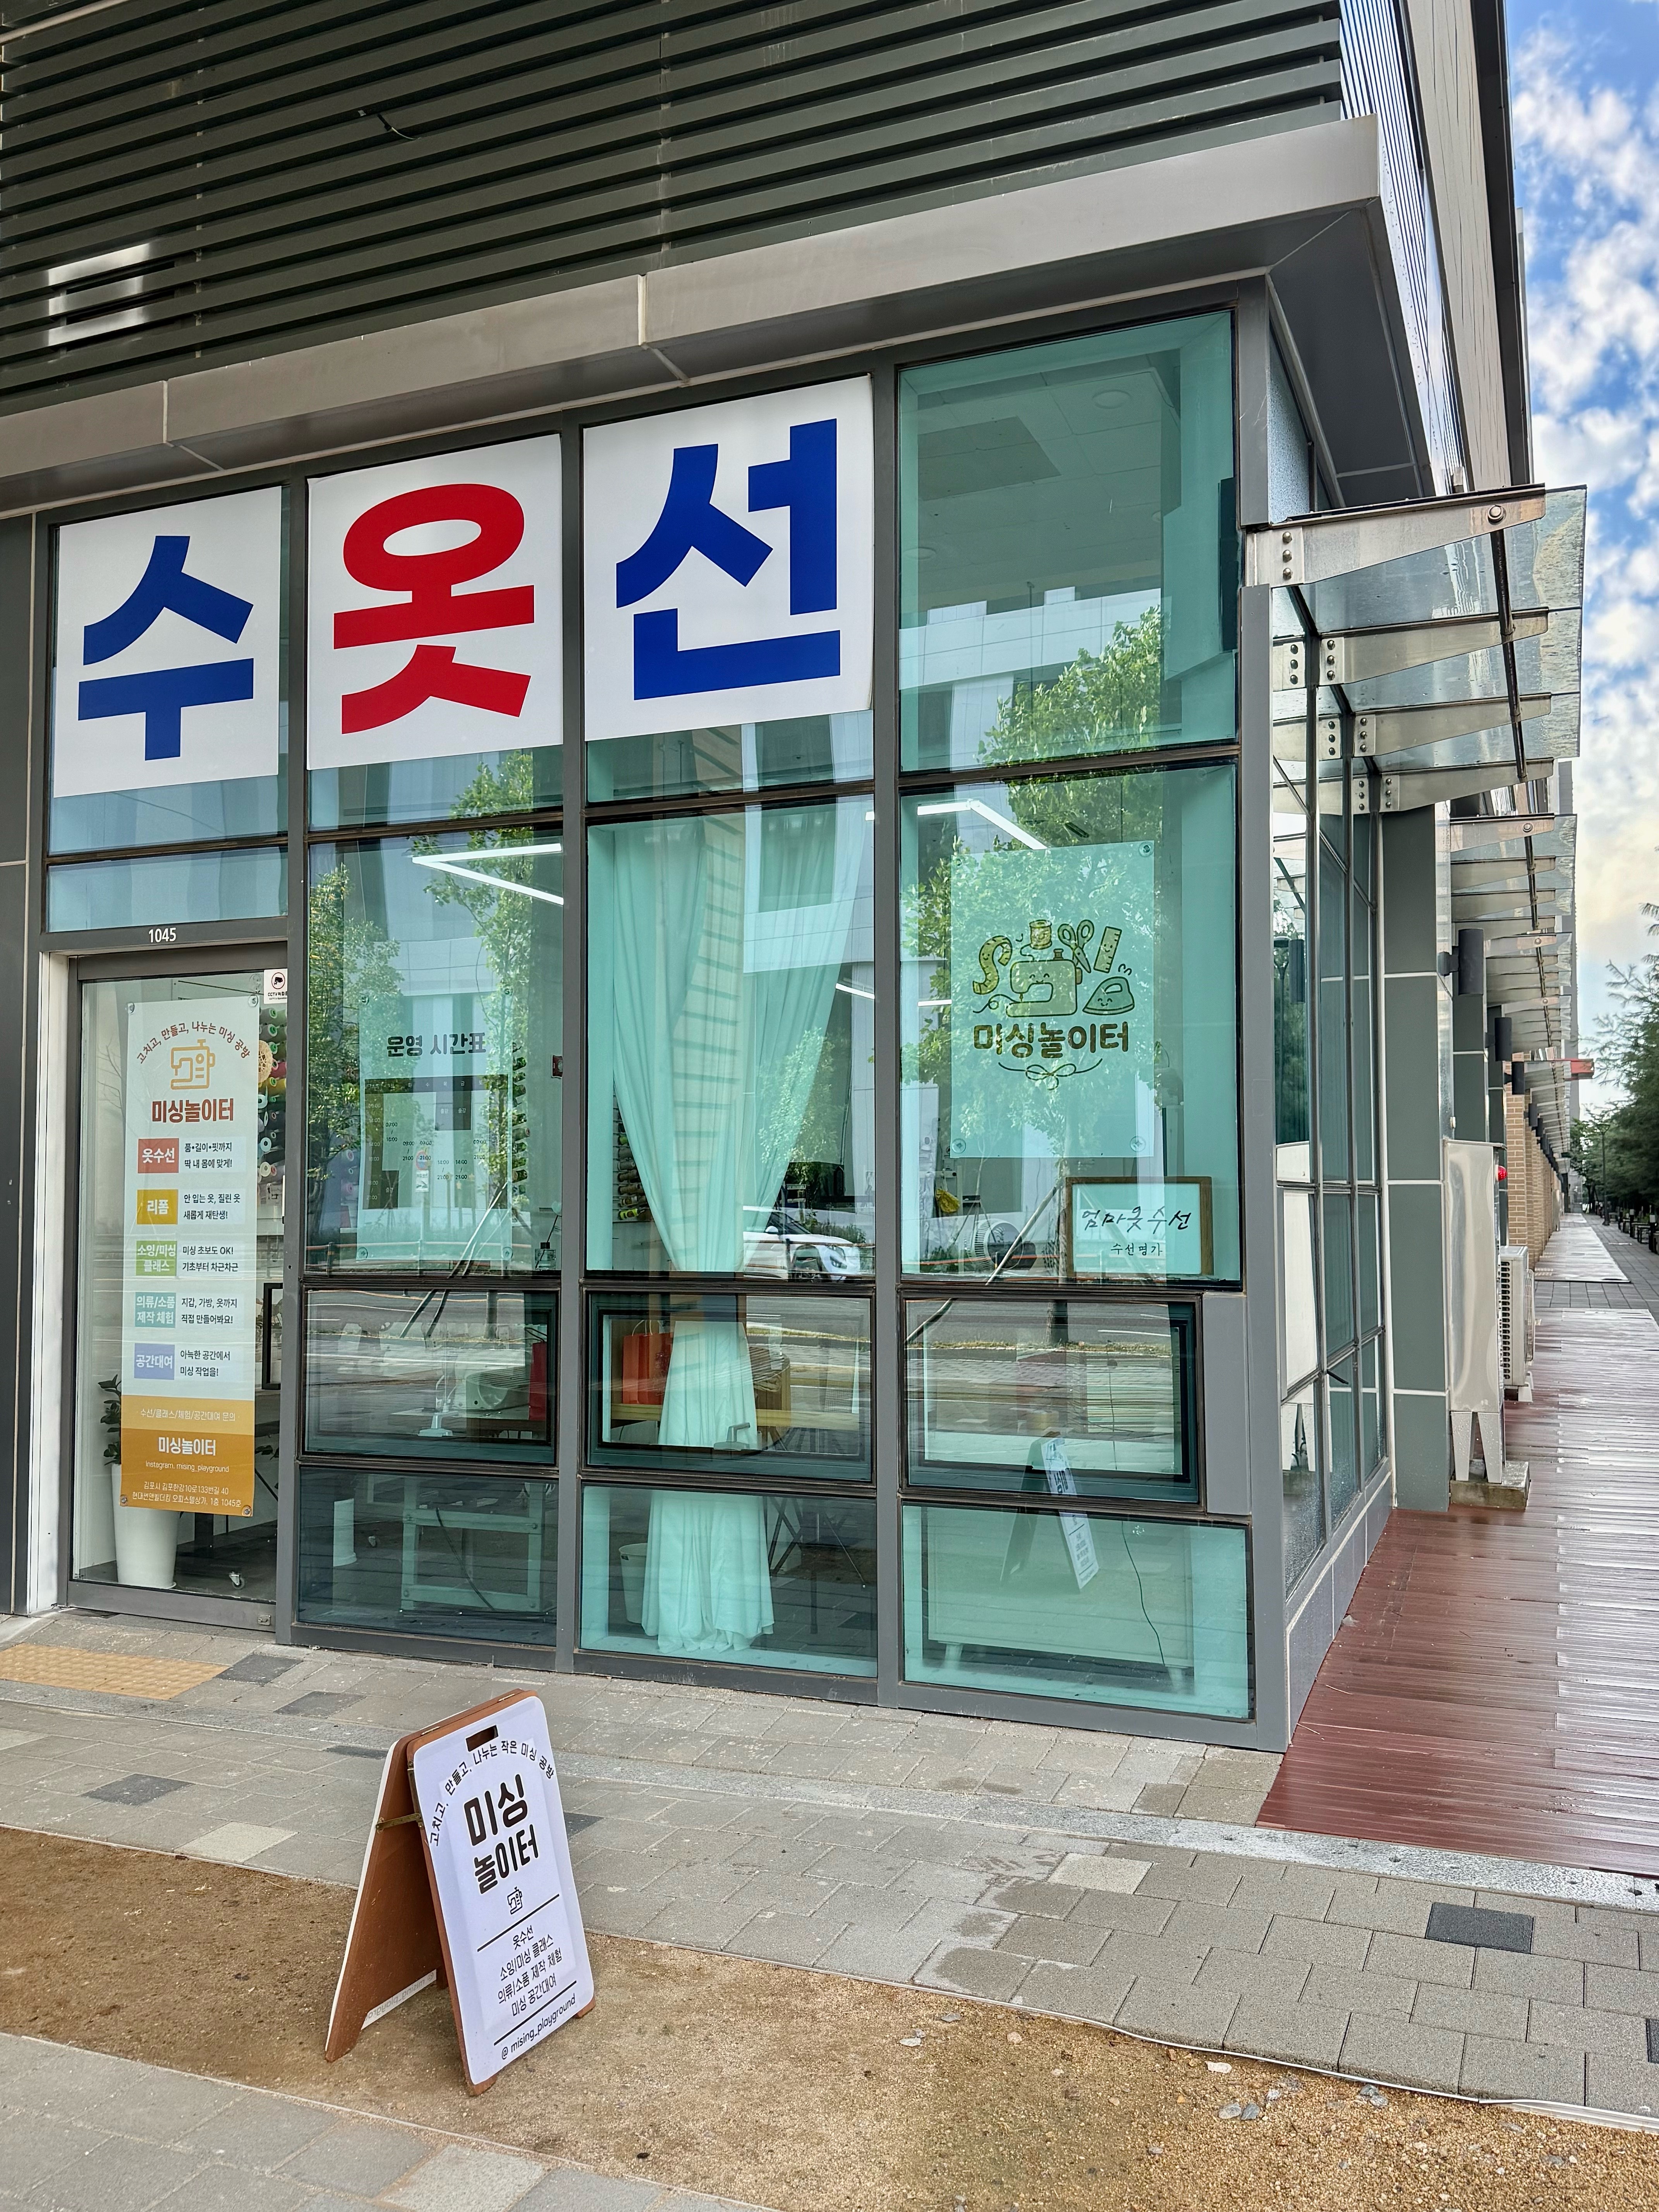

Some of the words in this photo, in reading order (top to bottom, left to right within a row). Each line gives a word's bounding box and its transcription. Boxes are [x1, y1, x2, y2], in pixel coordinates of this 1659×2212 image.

[78, 535, 254, 760] 수
[334, 483, 534, 734] 옷
[616, 418, 842, 700] 선
[149, 927, 176, 943] 1045
[137, 1038, 161, 1064] 고치고,
[161, 1023, 189, 1040] 만들고,
[192, 1021, 216, 1034] 나누는
[219, 1026, 235, 1043] 미싱
[234, 1039, 251, 1058] 공방
[387, 1035, 422, 1057] 운영
[430, 1032, 486, 1055] 시간표
[973, 1021, 1129, 1059] 미싱놀이터
[152, 1098, 234, 1123] 미싱놀이터
[142, 1147, 175, 1164] 옷수선
[185, 1159, 191, 1168] 딱
[193, 1159, 199, 1168] 내
[201, 1159, 215, 1168] 몸에
[217, 1159, 232, 1168] 맞게!
[184, 1194, 191, 1203] 안
[192, 1194, 206, 1203] 입는
[207, 1194, 216, 1204] 옷,
[218, 1194, 232, 1203] 질린
[234, 1194, 240, 1203] 옷
[147, 1199, 169, 1215] 리폼
[184, 1211, 204, 1220] 새롭게
[205, 1210, 228, 1219] 재탄생!
[137, 1244, 176, 1257] 소잉/미싱
[183, 1246, 196, 1255] 미싱
[198, 1246, 218, 1255] 초보도
[220, 1247, 233, 1255] OK!
[1110, 1243, 1163, 1257] 수선명가
[144, 1260, 170, 1272] 클래스
[182, 1262, 209, 1272] 기초부터
[211, 1262, 239, 1272] 차근차근
[136, 1295, 175, 1309] 의류/소품
[182, 1298, 197, 1308] 지갑,
[199, 1298, 214, 1308] 가방,
[216, 1298, 237, 1308] 옷까지
[137, 1311, 155, 1324] 제작
[156, 1312, 174, 1324] 체험
[181, 1314, 194, 1323] 직접
[196, 1315, 233, 1324] 만들어봐요!
[136, 1354, 173, 1369] 공간대여
[180, 1350, 201, 1359] 아늑한
[203, 1350, 230, 1360] 공간에서
[180, 1366, 193, 1376] 미싱
[195, 1367, 218, 1377] 작업을!
[222, 1412, 235, 1421] 문의
[158, 1437, 216, 1456] 미싱놀이터
[177, 1463, 229, 1474] mising_playground
[144, 1481, 160, 1490] 김포시
[222, 1499, 242, 1507] 1045호
[472, 1743, 498, 1765] 나누는
[501, 1740, 517, 1754] 작은
[521, 1743, 538, 1760] 미싱
[539, 1755, 554, 1779] 공방
[464, 1774, 528, 1846] 미싱
[474, 1824, 539, 1894] 놀이터
[513, 1925, 534, 1950] 옷수선
[500, 1950, 531, 1981] 소잉/미싱
[532, 1934, 554, 1958] 클래스
[498, 1971, 530, 2004] 의류/소품
[532, 1959, 546, 1981] 제작
[548, 1948, 563, 1968] 체험
[511, 1999, 527, 2016] 미싱
[528, 1972, 556, 2003] 공간대여
[511, 1993, 575, 2053] mising_playground
